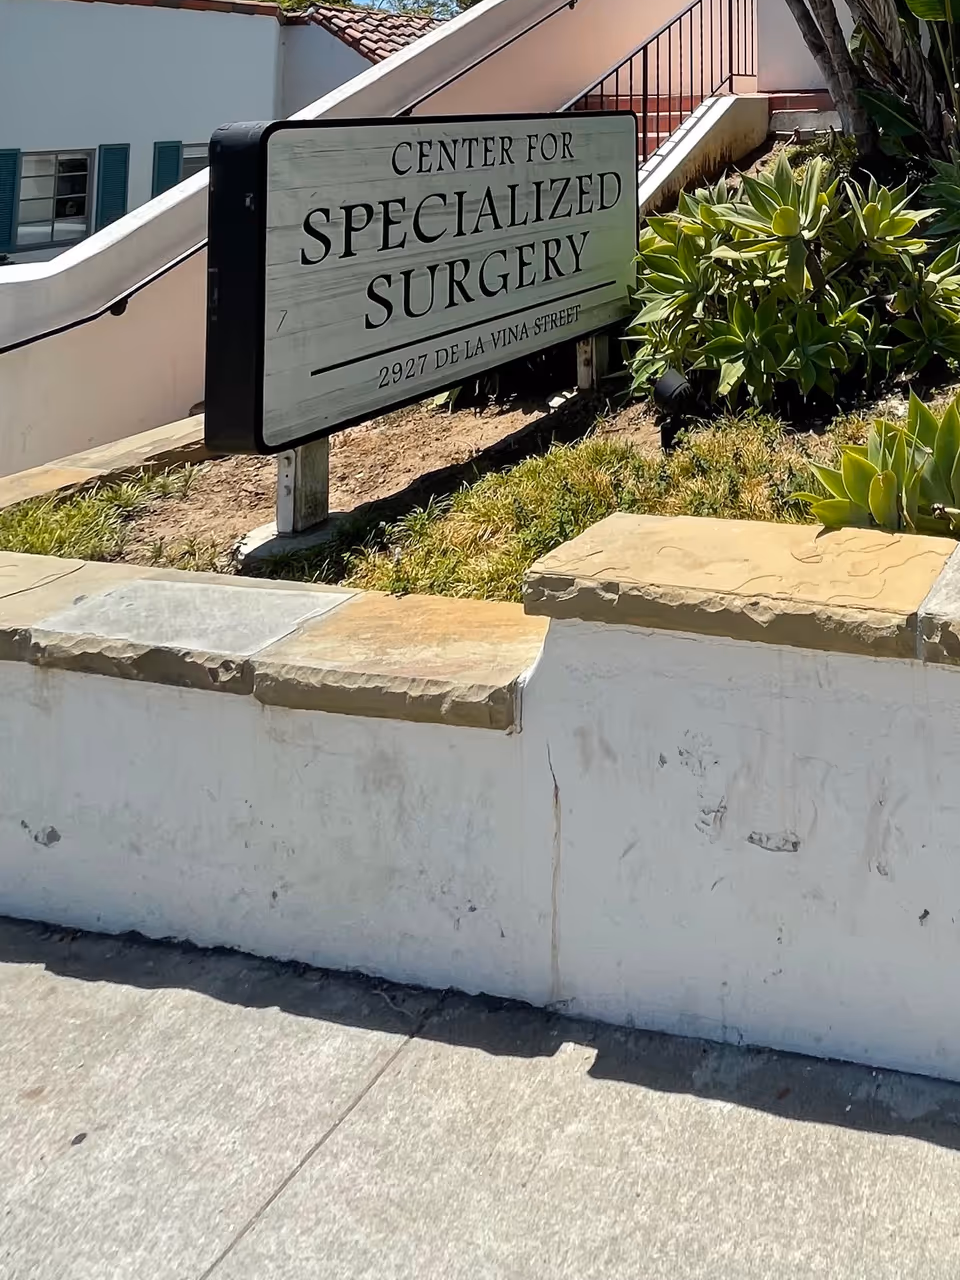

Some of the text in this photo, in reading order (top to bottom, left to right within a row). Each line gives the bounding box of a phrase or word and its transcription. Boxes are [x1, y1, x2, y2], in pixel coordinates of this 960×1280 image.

[391, 131, 575, 176] CENTER FOR
[300, 171, 622, 266] SPECIALIZED
[364, 231, 590, 330] SURGERY
[378, 305, 581, 390] 2927 DE LA VINA STREET
